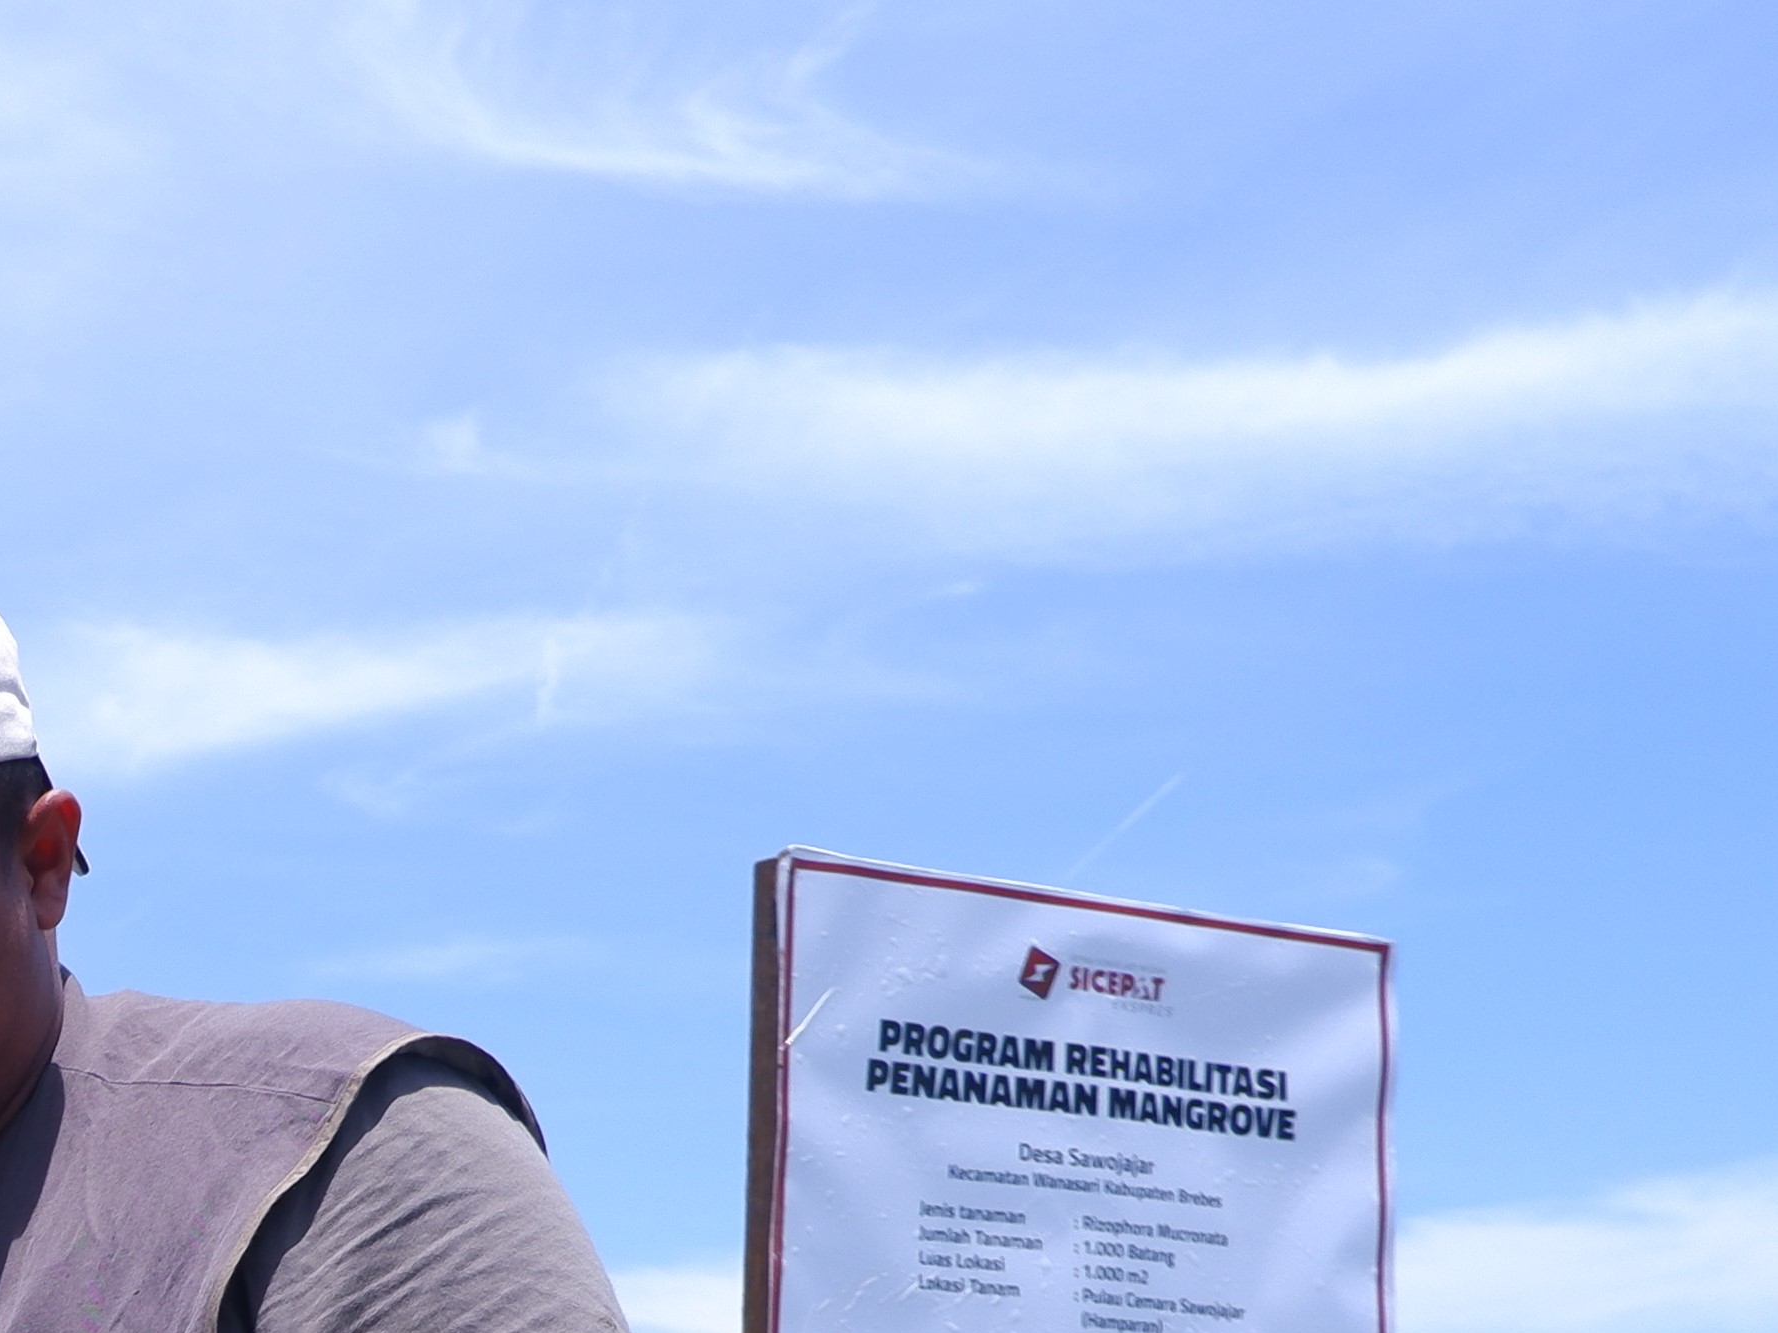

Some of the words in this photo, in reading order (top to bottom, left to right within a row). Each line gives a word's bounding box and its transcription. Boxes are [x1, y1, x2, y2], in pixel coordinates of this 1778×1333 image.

[879, 1018, 1055, 1073] PROGRAM
[1065, 1042, 1287, 1102] REHABILITASI
[866, 1058, 1098, 1116] PENANAMAN
[1108, 1086, 1297, 1141] MANGROVE
[1019, 1142, 1064, 1166] Desa
[1068, 1147, 1155, 1178] Sawojajar
[947, 1163, 1030, 1187] Kecamatan
[1032, 1172, 1100, 1194] Wanasari
[1102, 1179, 1176, 1202] Kabupaten
[1176, 1187, 1223, 1208] Brebes
[918, 1200, 956, 1219] Jenis
[958, 1204, 1027, 1225] tanaman
[1156, 1223, 1230, 1248] Mucronata
[918, 1225, 971, 1245] Jumlah
[973, 1229, 1044, 1251] Tanaman
[1083, 1240, 1125, 1259] 1.000
[1127, 1244, 1176, 1268] Batang
[917, 1250, 953, 1268] Luas
[955, 1252, 1006, 1272] Lokasi
[1083, 1264, 1125, 1283] 1.000
[918, 1274, 965, 1294] Lokasi
[969, 1278, 1021, 1298] Tanam
[1081, 1287, 1124, 1307] Pulau
[1125, 1291, 1177, 1314] Cemara
[1178, 1297, 1247, 1322] Sawojajar
